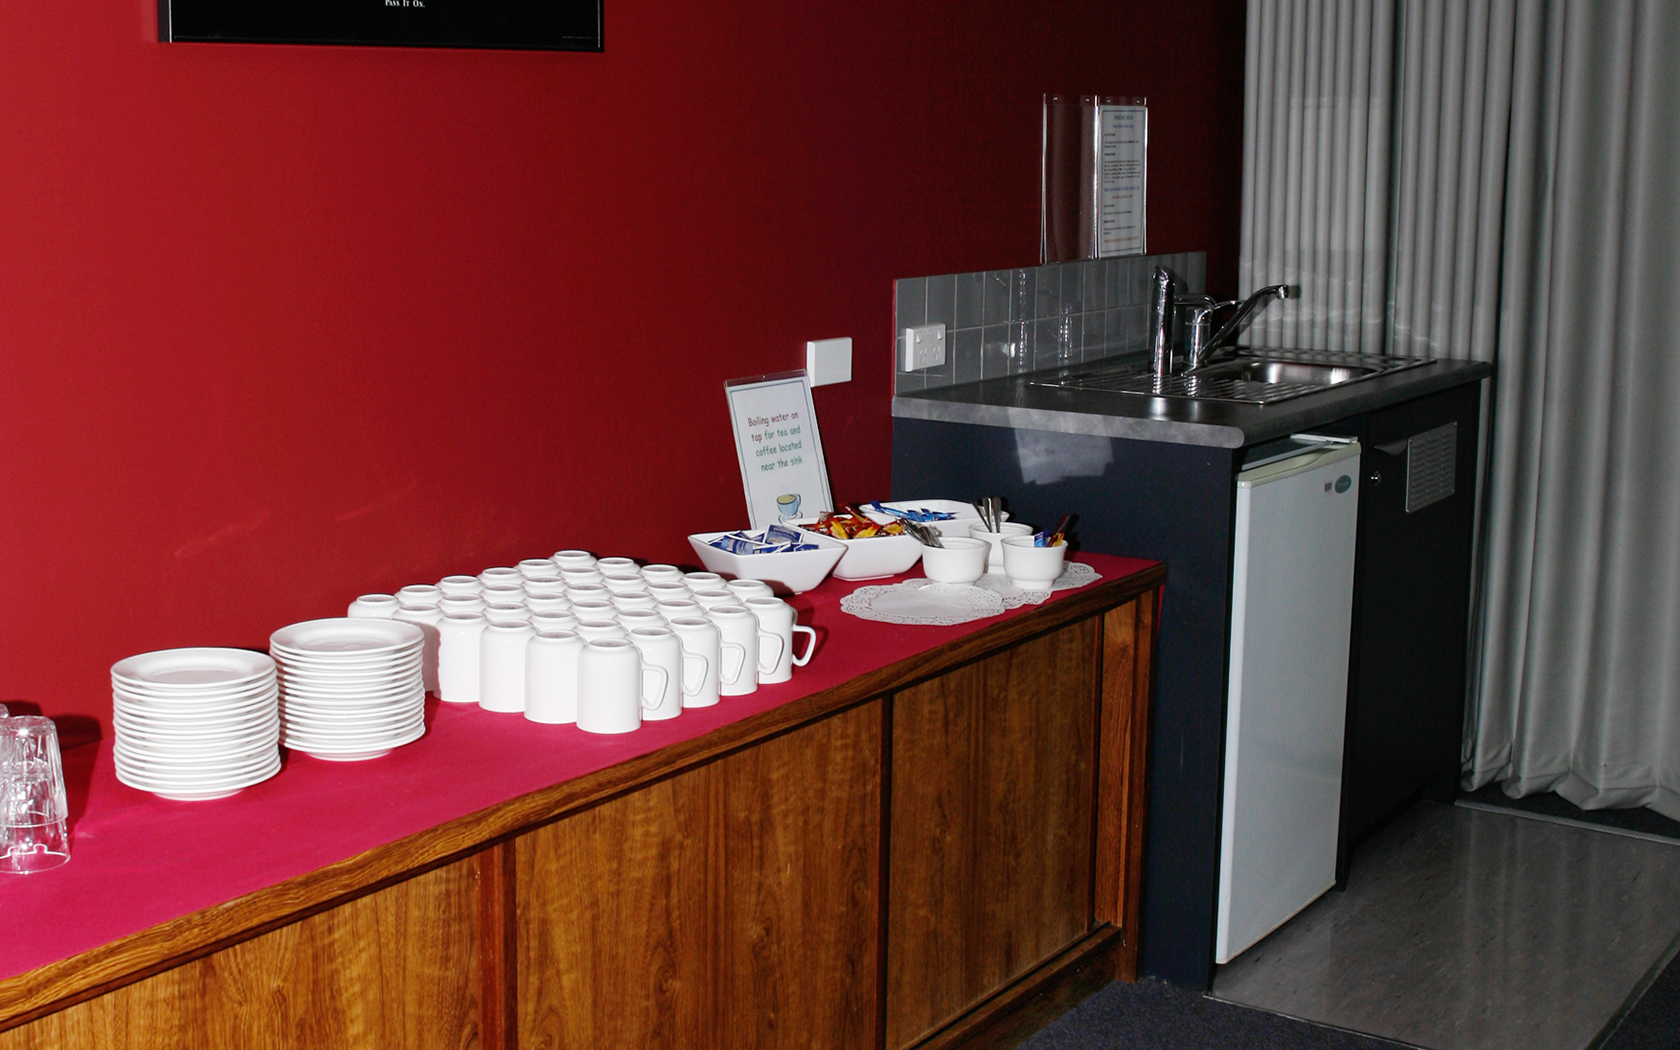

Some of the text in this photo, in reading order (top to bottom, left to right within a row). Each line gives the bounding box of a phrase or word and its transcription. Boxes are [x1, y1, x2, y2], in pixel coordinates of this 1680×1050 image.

[748, 412, 799, 427] Boiling water on
[751, 434, 762, 443] tap
[764, 430, 774, 440] for
[790, 425, 801, 435] and
[756, 440, 802, 457] coffee located
[761, 455, 803, 471] near the sink
